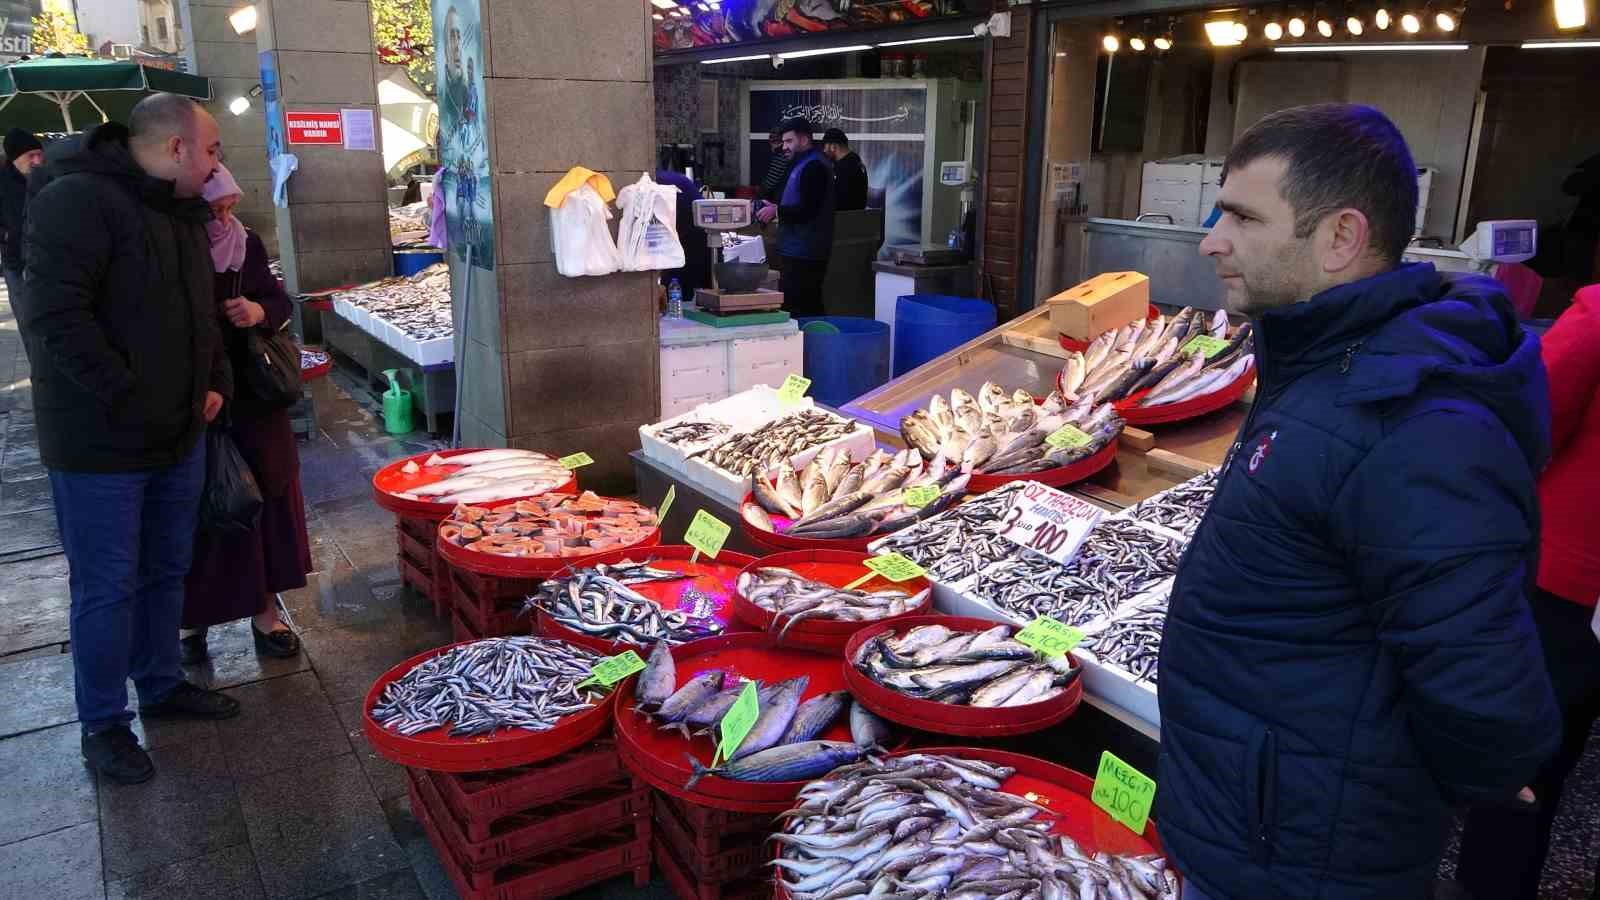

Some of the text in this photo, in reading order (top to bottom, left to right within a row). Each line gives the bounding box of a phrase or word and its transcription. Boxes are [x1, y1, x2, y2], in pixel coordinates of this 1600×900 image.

[1000, 506, 1023, 535] 3
[1024, 520, 1069, 555] 100
[1109, 787, 1144, 822] 100
